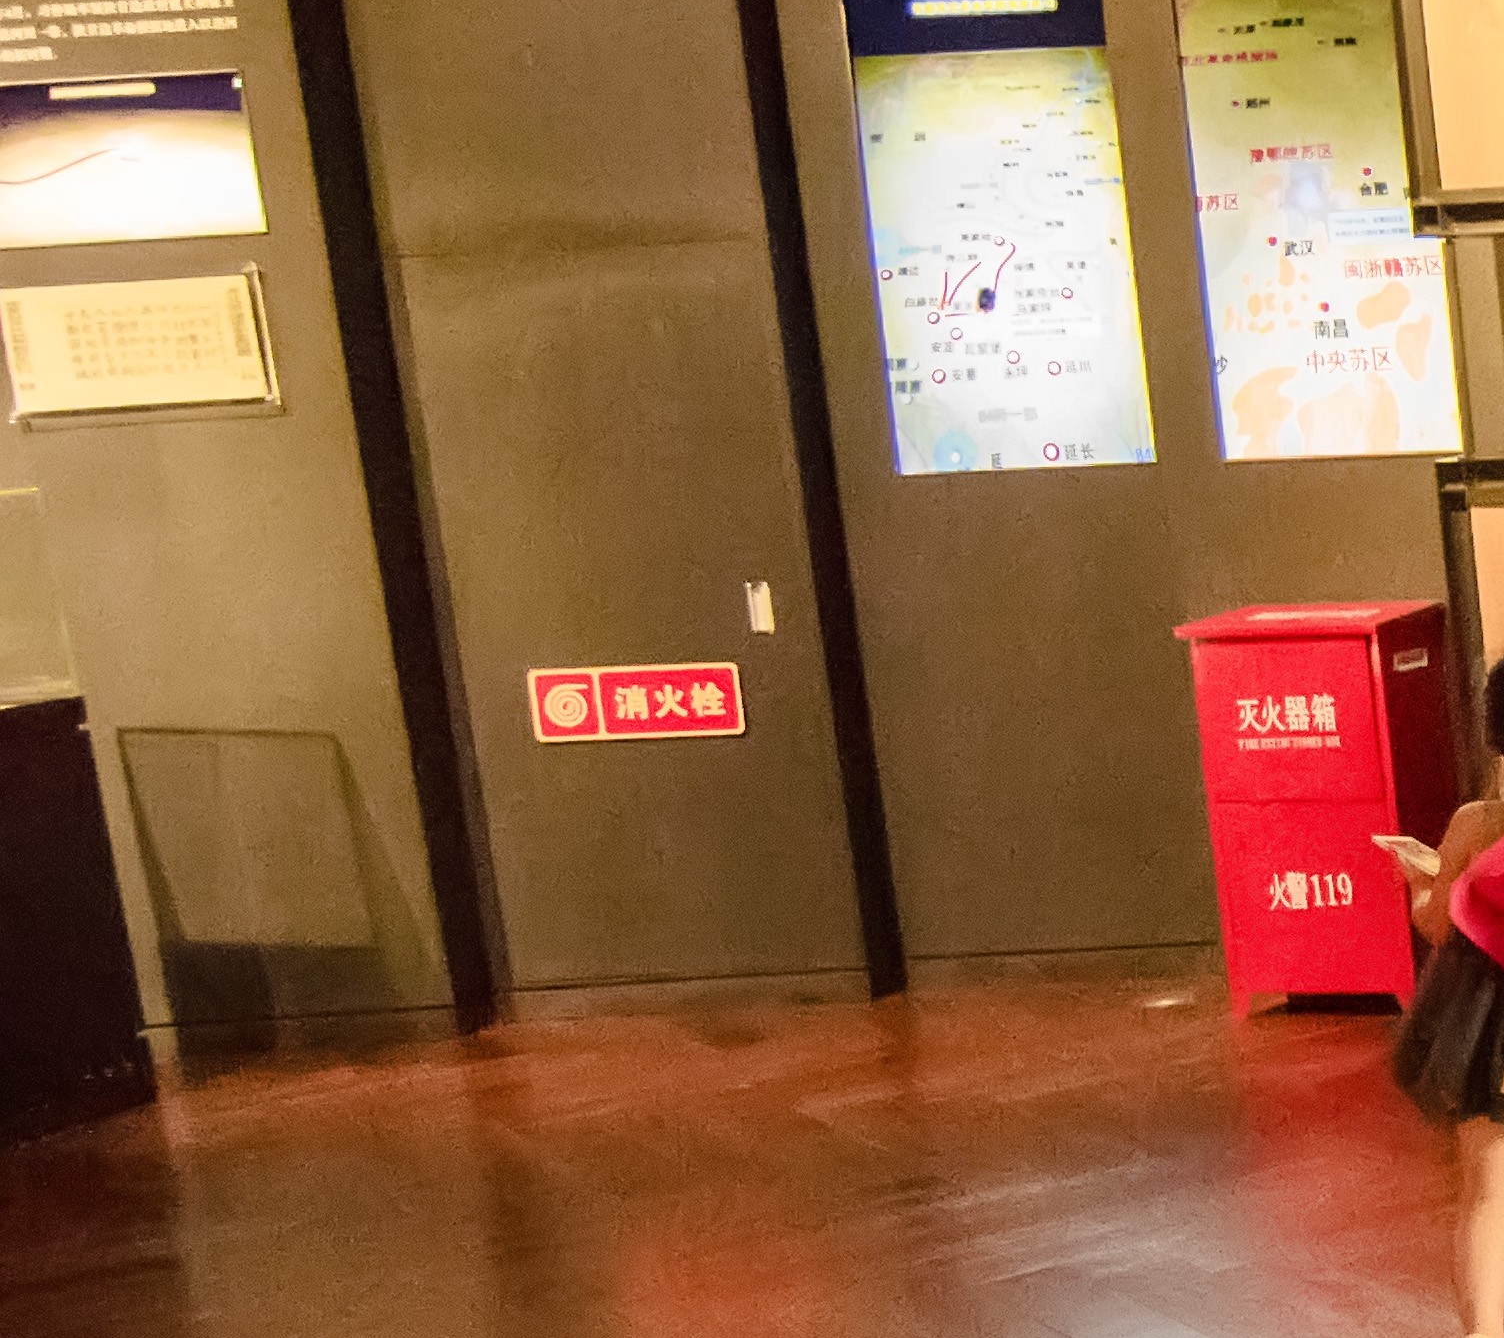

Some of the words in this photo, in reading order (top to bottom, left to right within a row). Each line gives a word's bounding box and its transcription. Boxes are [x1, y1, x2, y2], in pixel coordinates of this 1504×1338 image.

[1314, 318, 1349, 340] 南昌
[1306, 345, 1394, 374] 中央苏区
[614, 681, 727, 722] 消火栓
[1236, 692, 1338, 734] 灭火器箱
[1269, 870, 1354, 912] 火警119
